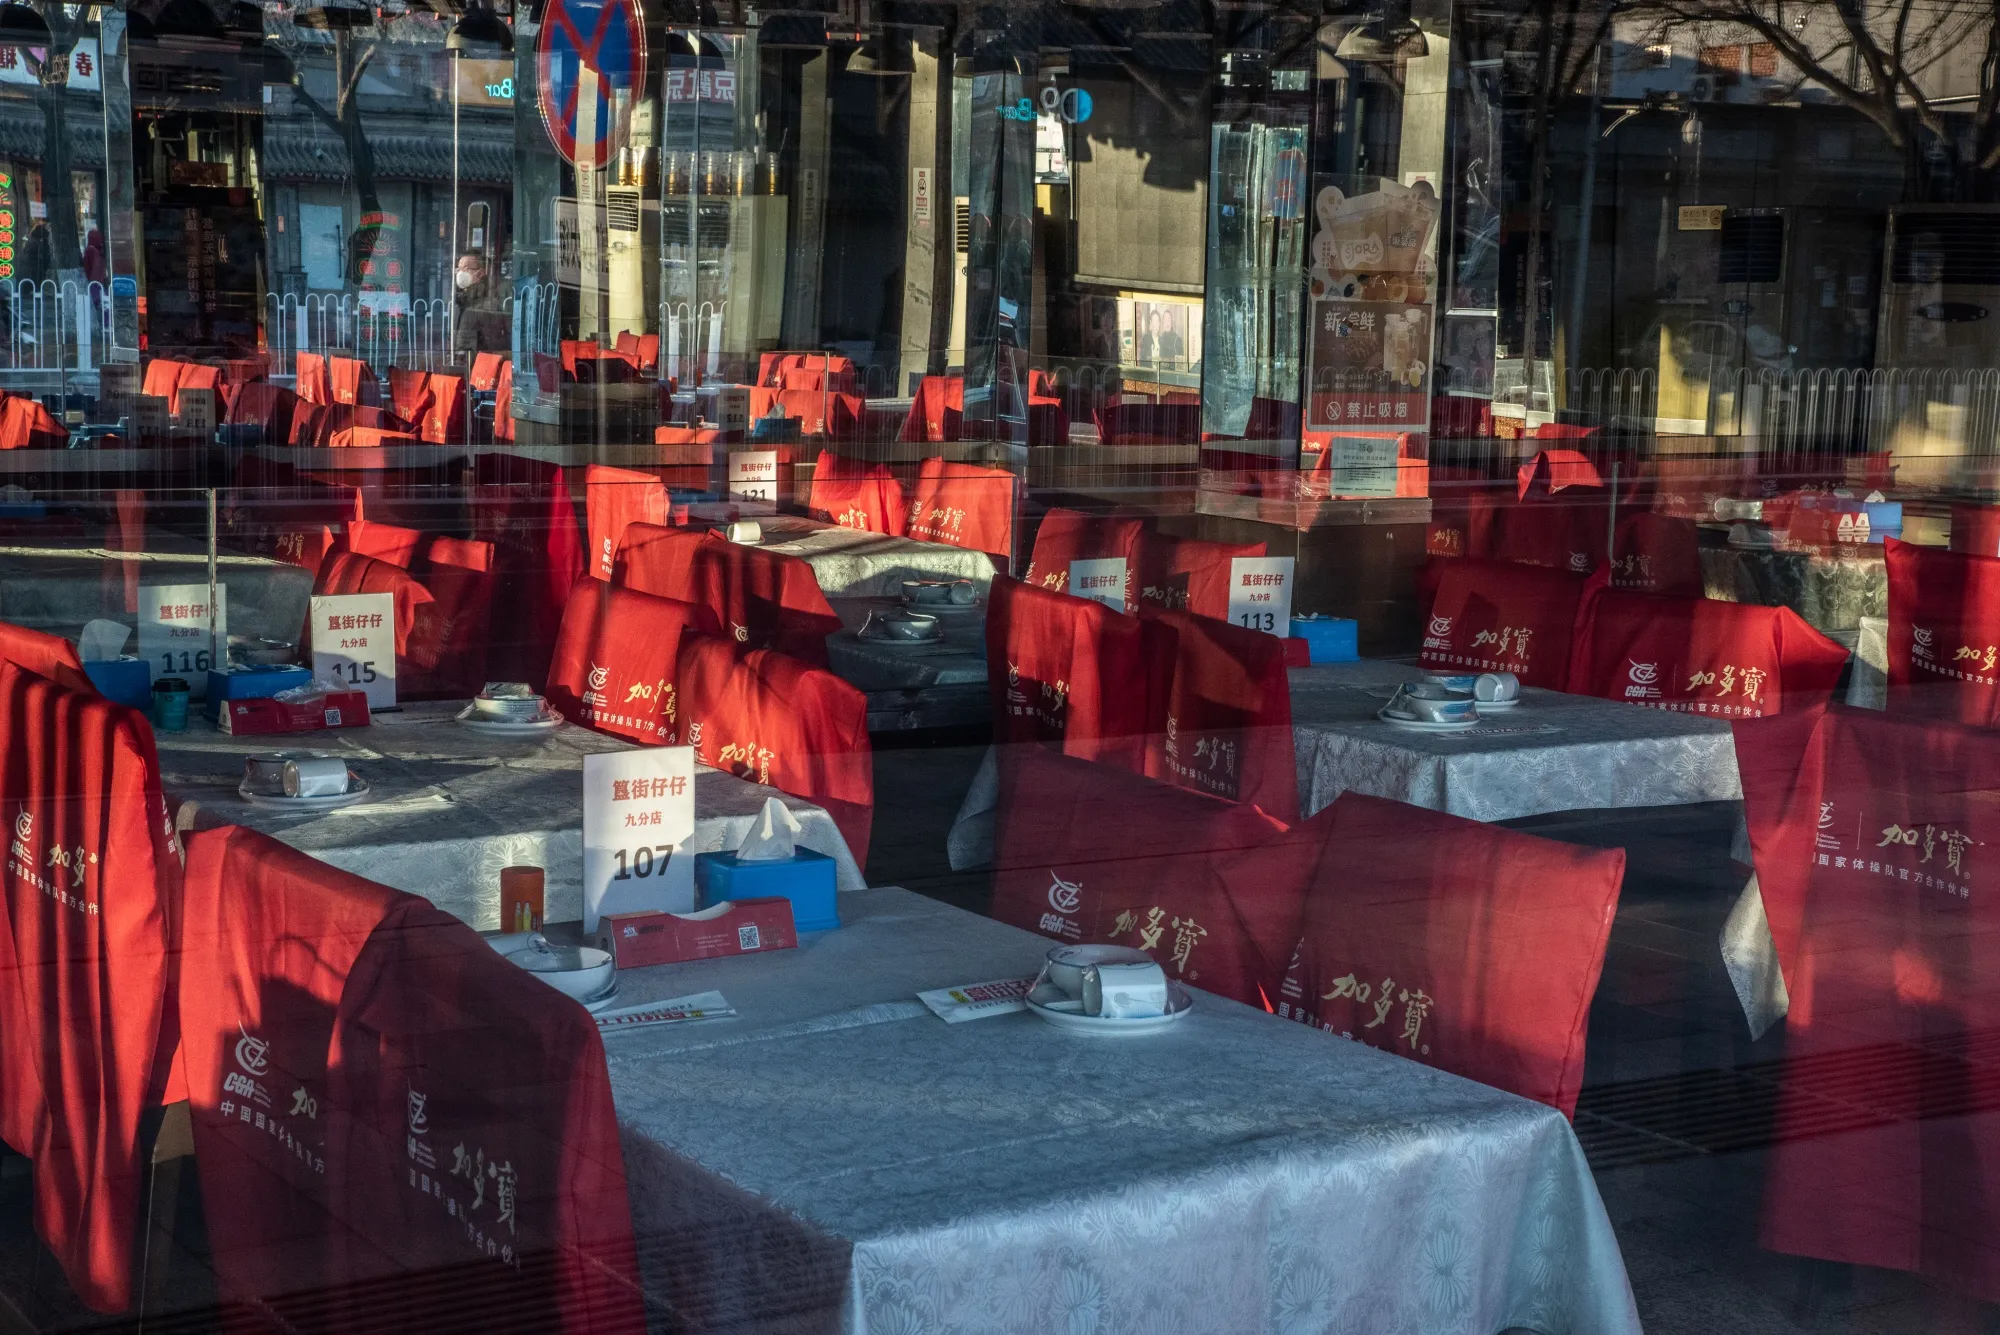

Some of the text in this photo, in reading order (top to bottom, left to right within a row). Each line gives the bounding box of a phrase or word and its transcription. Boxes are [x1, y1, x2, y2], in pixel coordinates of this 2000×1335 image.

[1347, 402, 1407, 418] 禁止吸烟
[742, 489, 766, 502] 121
[1080, 575, 1118, 589] 簋街仔仔
[1242, 574, 1284, 586] 簋街仔仔
[1249, 593, 1271, 602] 九分店
[328, 613, 383, 631] 簋街仔仔
[1241, 613, 1275, 632] 113
[169, 627, 200, 637] 九分店
[340, 638, 368, 648] 九分店
[162, 650, 210, 674] 116
[332, 661, 377, 684] 115
[1624, 685, 1648, 698] CGA
[612, 776, 687, 801] 簋街仔仔
[624, 811, 662, 828] 九分店
[613, 844, 674, 881] 107
[1812, 852, 1969, 898] 国家体操队官方合作伙伴
[1039, 912, 1065, 934] CGA
[223, 1072, 255, 1098] CGA
